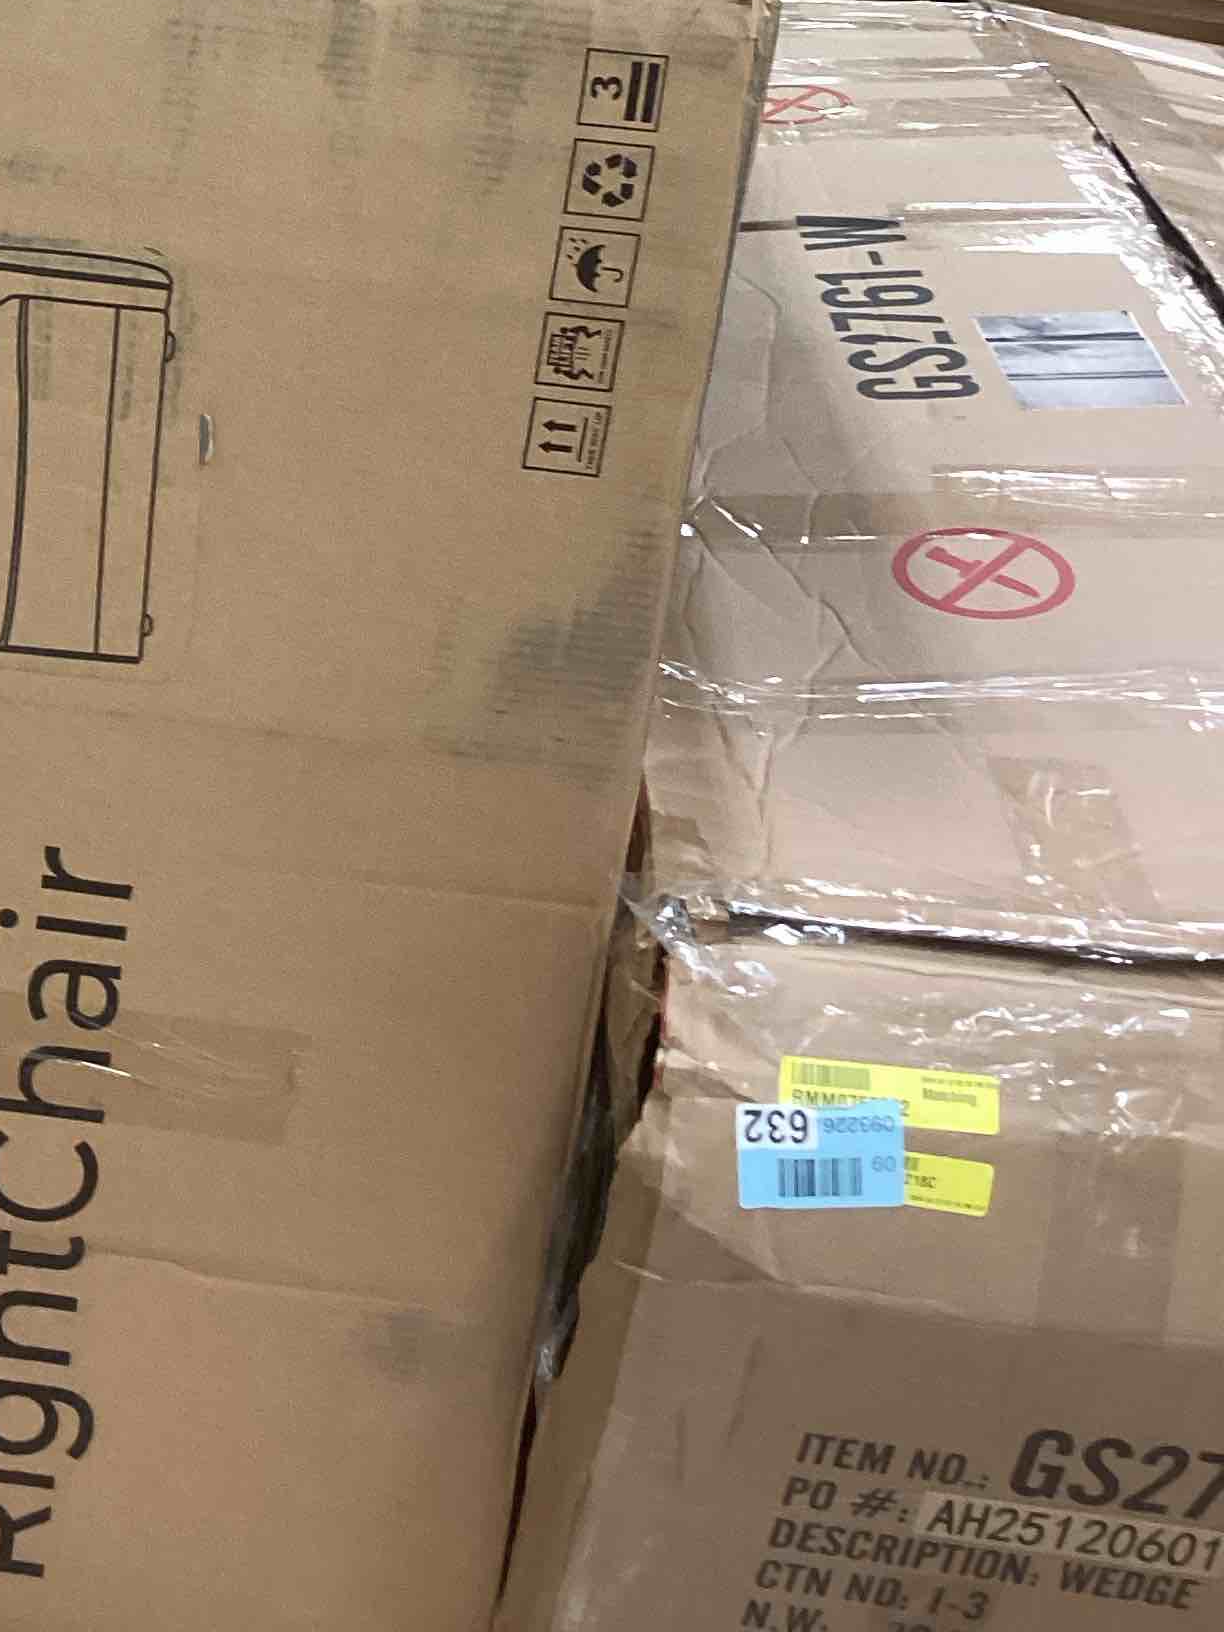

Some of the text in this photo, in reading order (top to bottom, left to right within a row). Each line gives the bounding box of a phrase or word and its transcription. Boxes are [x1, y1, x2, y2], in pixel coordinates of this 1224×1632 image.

[590, 76, 624, 100] 3
[795, 214, 981, 401] GS2761-W
[743, 1109, 809, 1144] 632
[795, 1431, 897, 1475] ITEM
[781, 1476, 838, 1512] PO
[755, 1559, 832, 1599] CTN
[768, 1516, 1202, 1611] DESCRIPTION: WEDGE
